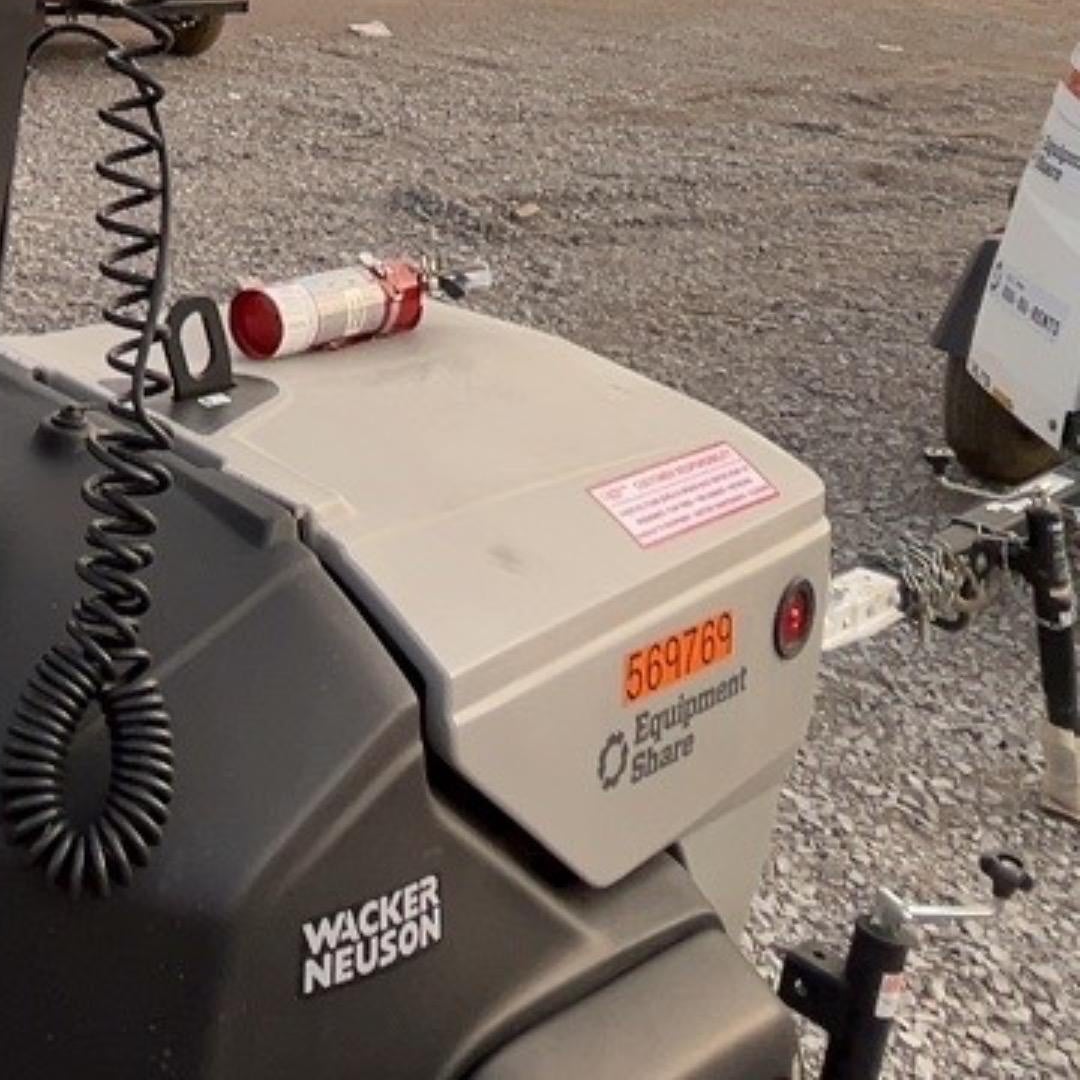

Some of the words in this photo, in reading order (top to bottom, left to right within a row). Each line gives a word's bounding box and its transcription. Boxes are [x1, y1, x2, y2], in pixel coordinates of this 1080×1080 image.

[626, 611, 733, 701] 569769
[634, 666, 748, 745] Equipment
[630, 733, 695, 784] Share
[302, 875, 441, 956] WACKER
[303, 908, 442, 994] NEUSON
